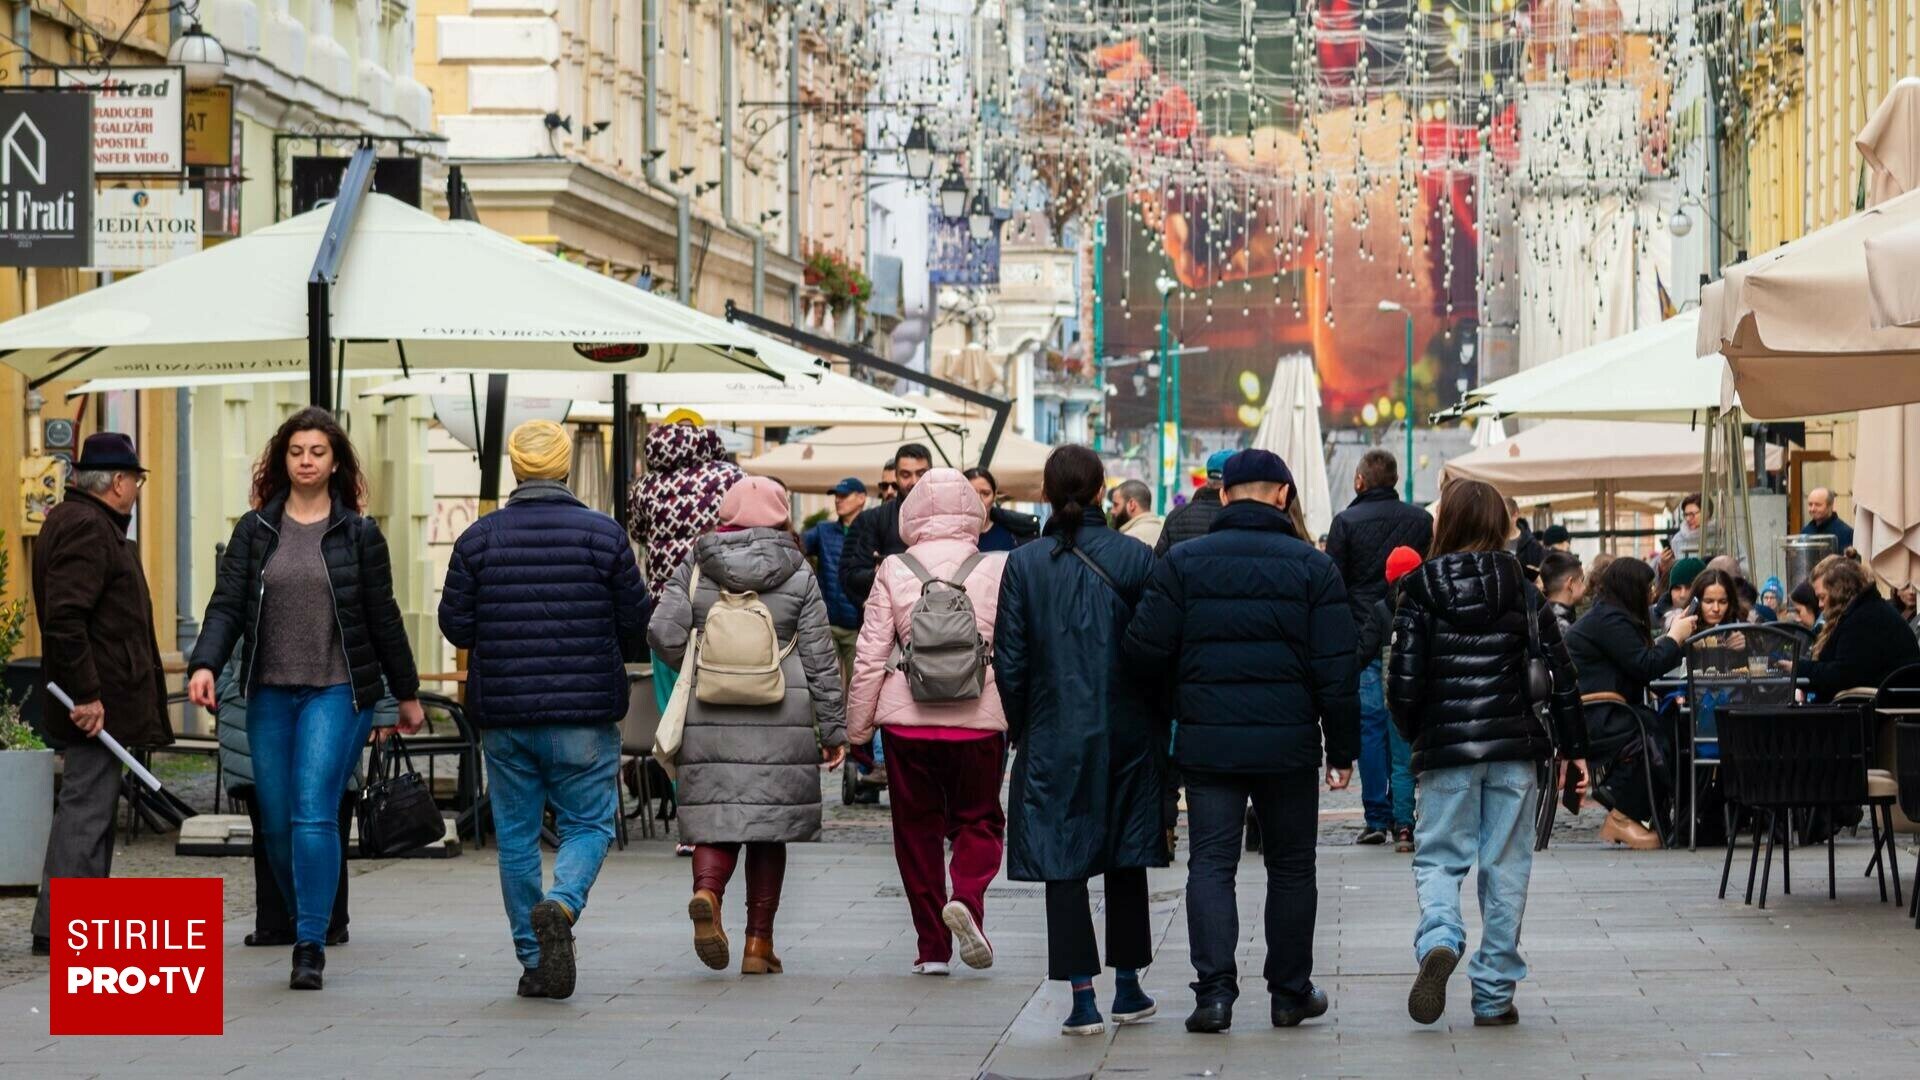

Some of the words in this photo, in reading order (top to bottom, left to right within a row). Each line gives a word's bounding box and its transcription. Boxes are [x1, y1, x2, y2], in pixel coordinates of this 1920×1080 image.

[187, 112, 208, 131] AT
[95, 152, 130, 164] NSFER
[133, 152, 169, 164] VIDEO
[0, 191, 8, 230] i
[16, 190, 74, 230] Frati
